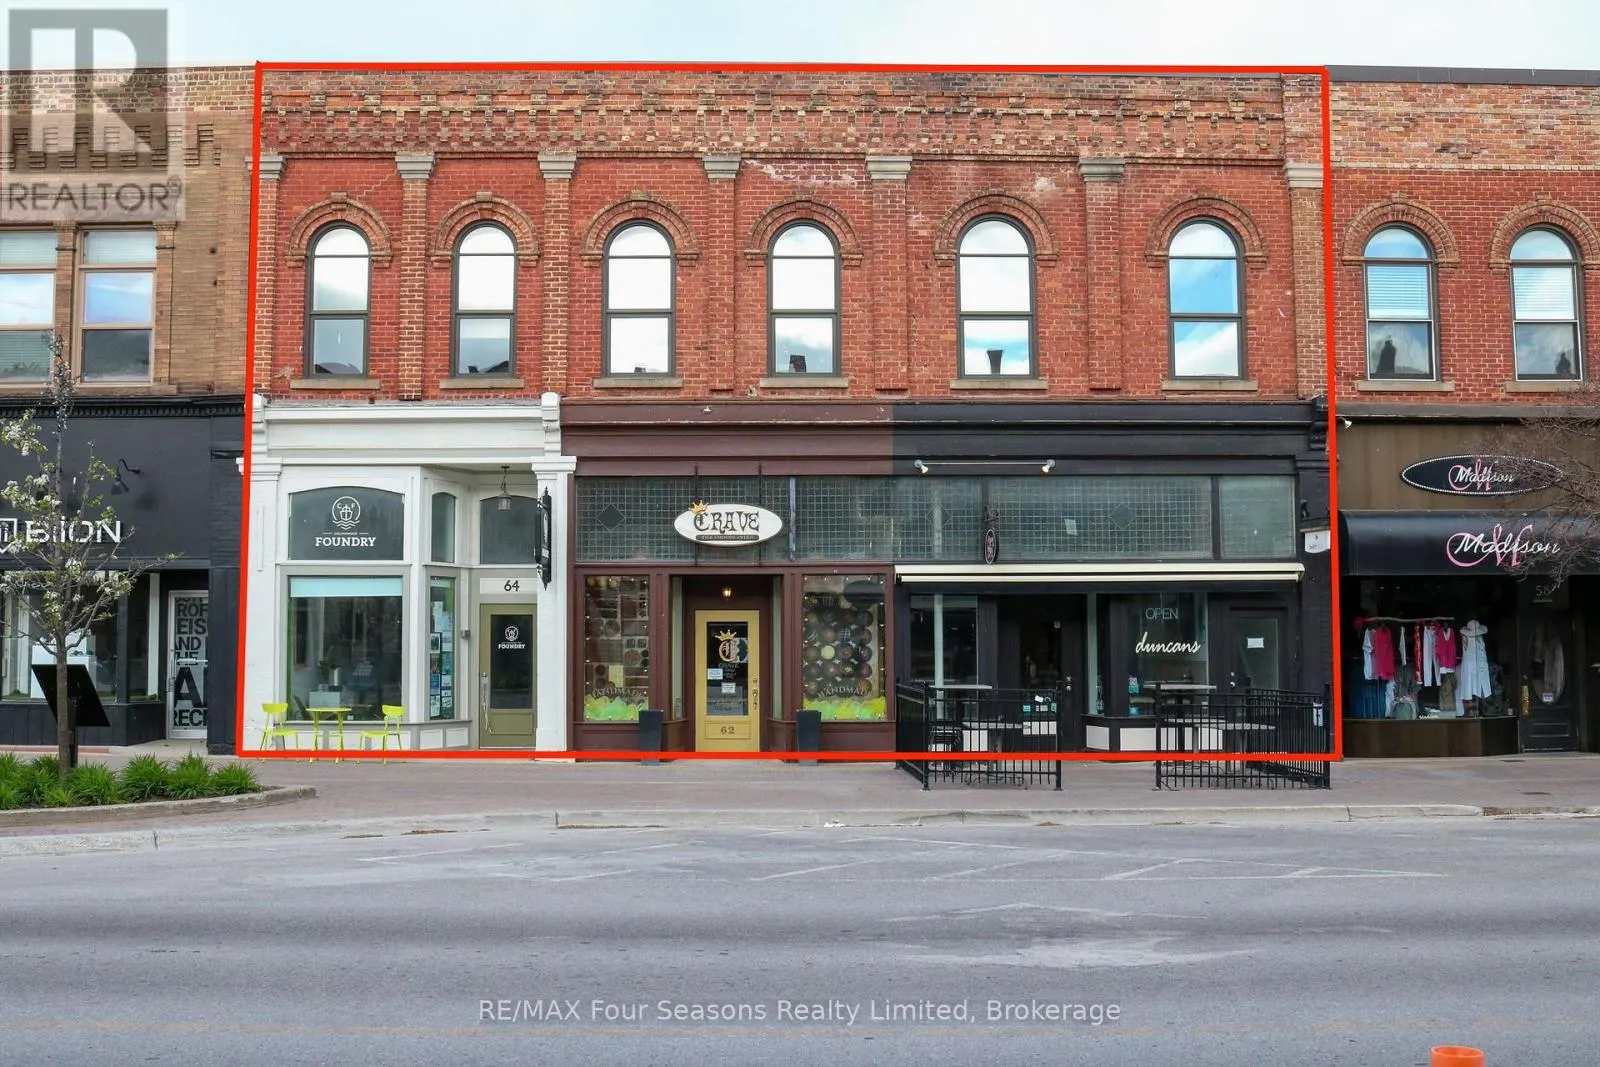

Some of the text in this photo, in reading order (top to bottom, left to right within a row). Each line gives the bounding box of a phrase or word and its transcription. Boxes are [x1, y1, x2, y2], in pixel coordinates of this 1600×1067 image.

[693, 511, 760, 534] CRAVE
[315, 537, 376, 547] FOUNDRY
[1454, 533, 1560, 554] Madison
[504, 580, 520, 592] 64
[1145, 607, 1179, 620] OPEN
[1135, 631, 1201, 654] duncans
[720, 726, 735, 735] 62
